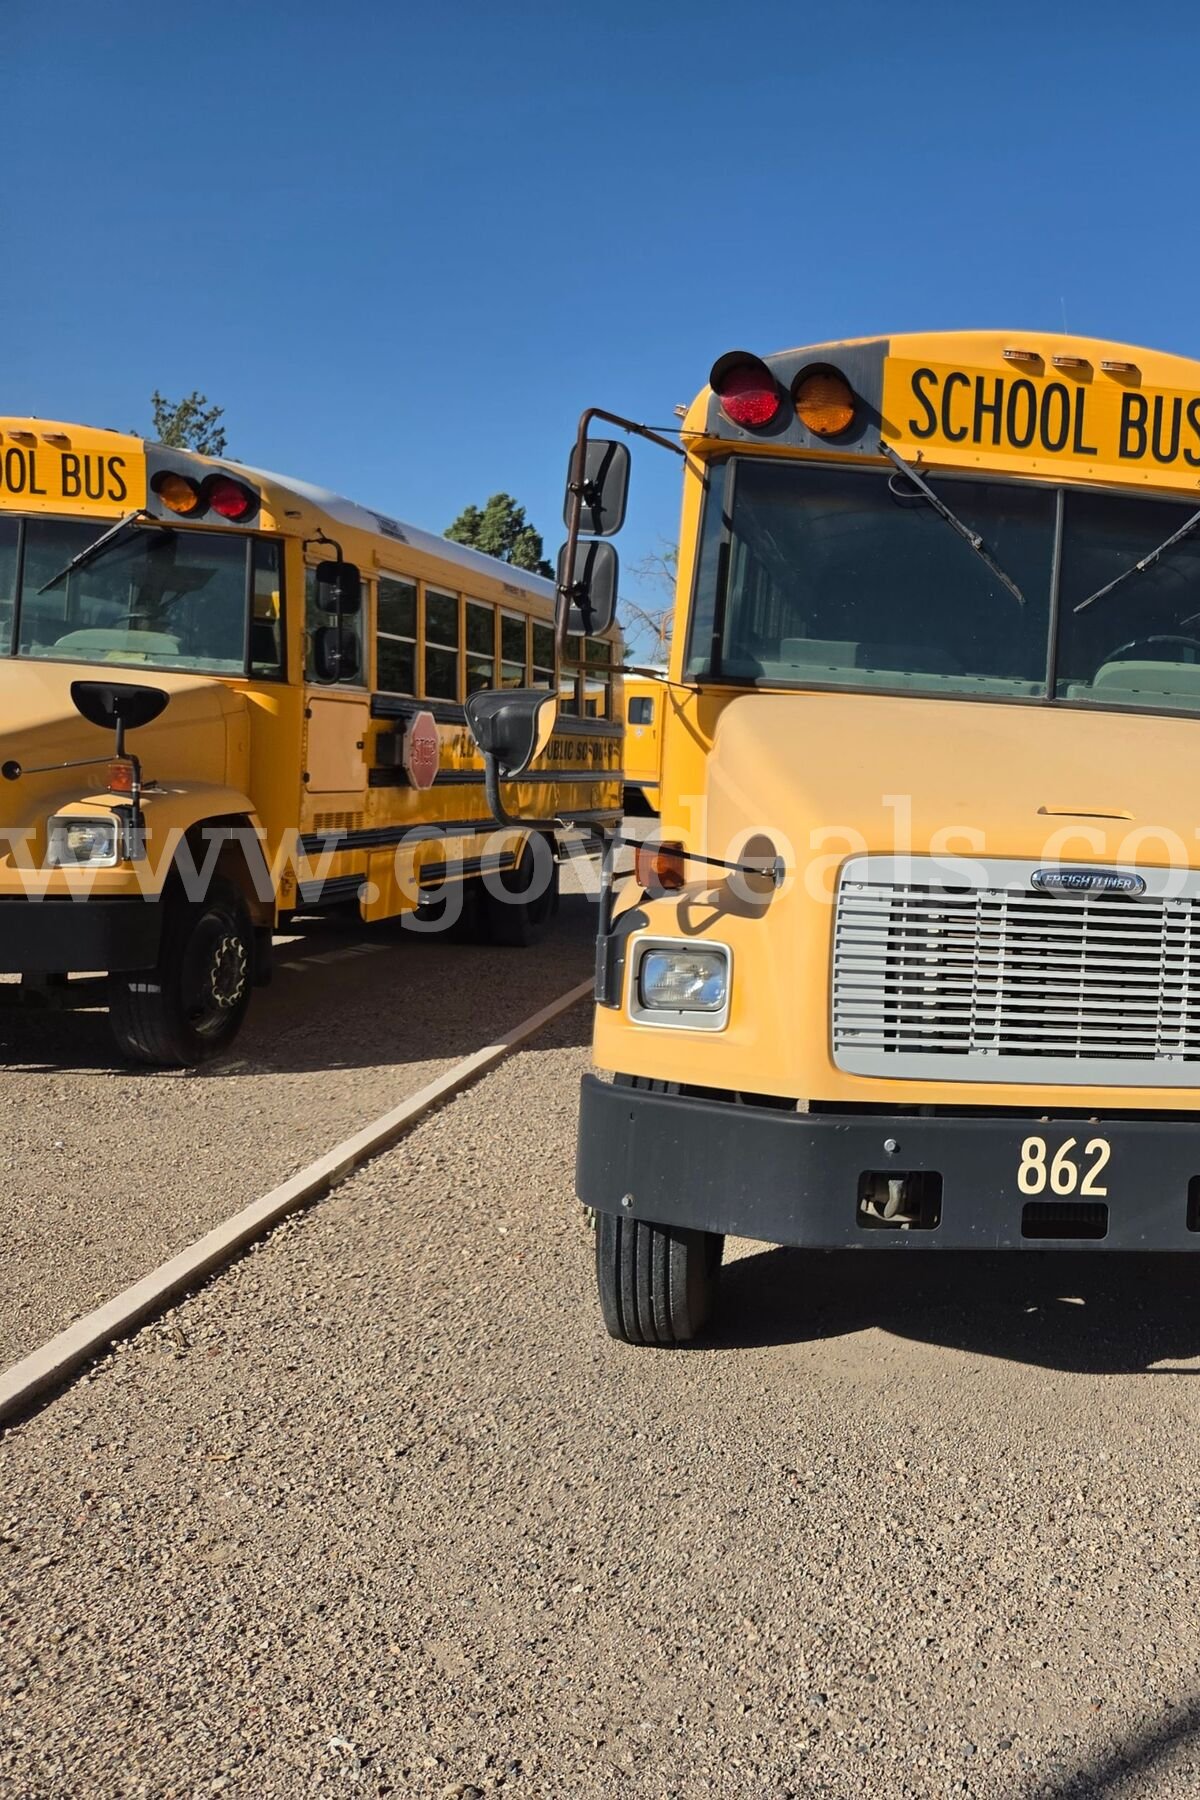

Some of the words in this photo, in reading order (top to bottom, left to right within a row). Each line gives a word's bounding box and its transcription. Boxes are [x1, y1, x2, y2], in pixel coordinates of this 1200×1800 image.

[908, 367, 1098, 457] SCHOOL
[0, 446, 48, 496] OL
[60, 452, 128, 502] BUS
[541, 739, 575, 761] UBLIC
[1044, 874, 1133, 889] FREIGHTLINER
[1016, 1136, 1111, 1197] 862
